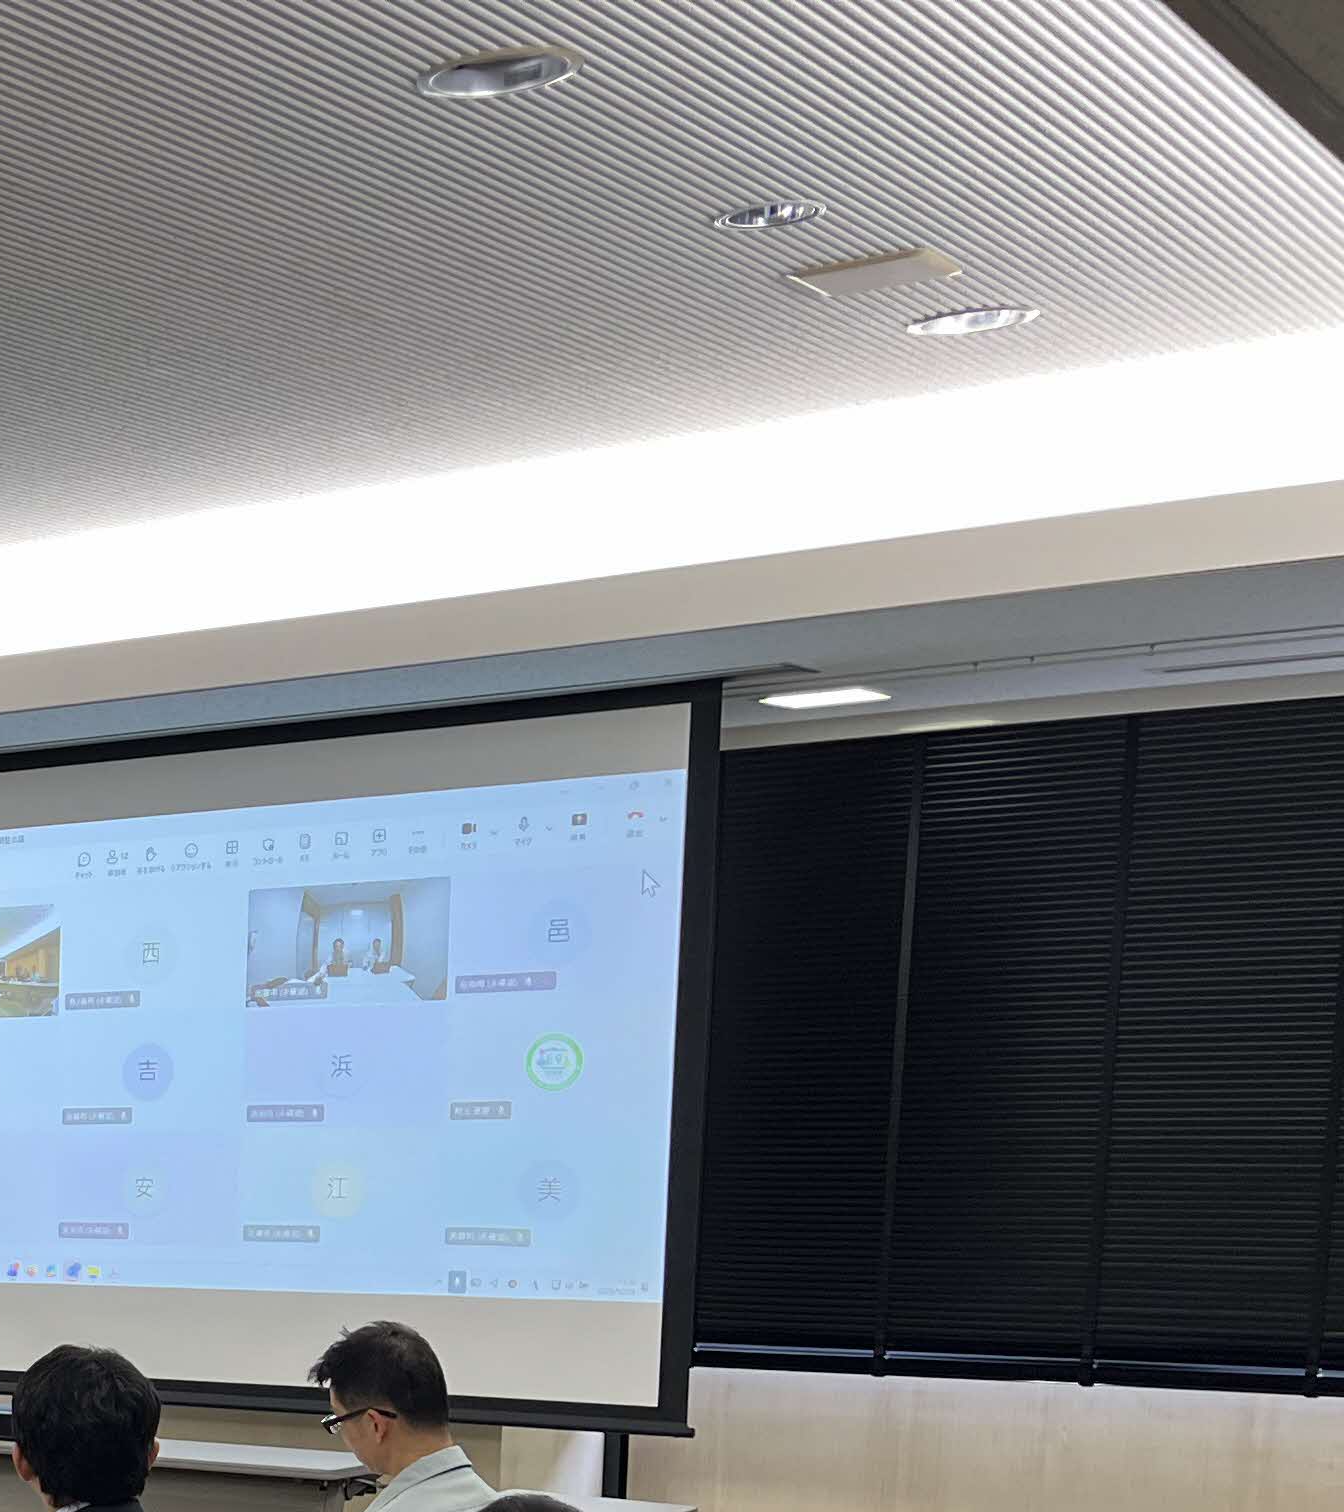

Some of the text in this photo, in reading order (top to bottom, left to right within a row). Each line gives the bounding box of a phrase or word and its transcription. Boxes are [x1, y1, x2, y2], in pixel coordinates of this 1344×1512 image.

[548, 918, 570, 943] 邑
[142, 942, 161, 965] 西
[138, 1060, 158, 1081] 吉
[330, 1054, 352, 1079] 浜
[135, 1177, 154, 1199] 安
[327, 1177, 350, 1200] 江
[537, 1177, 562, 1203] 美
